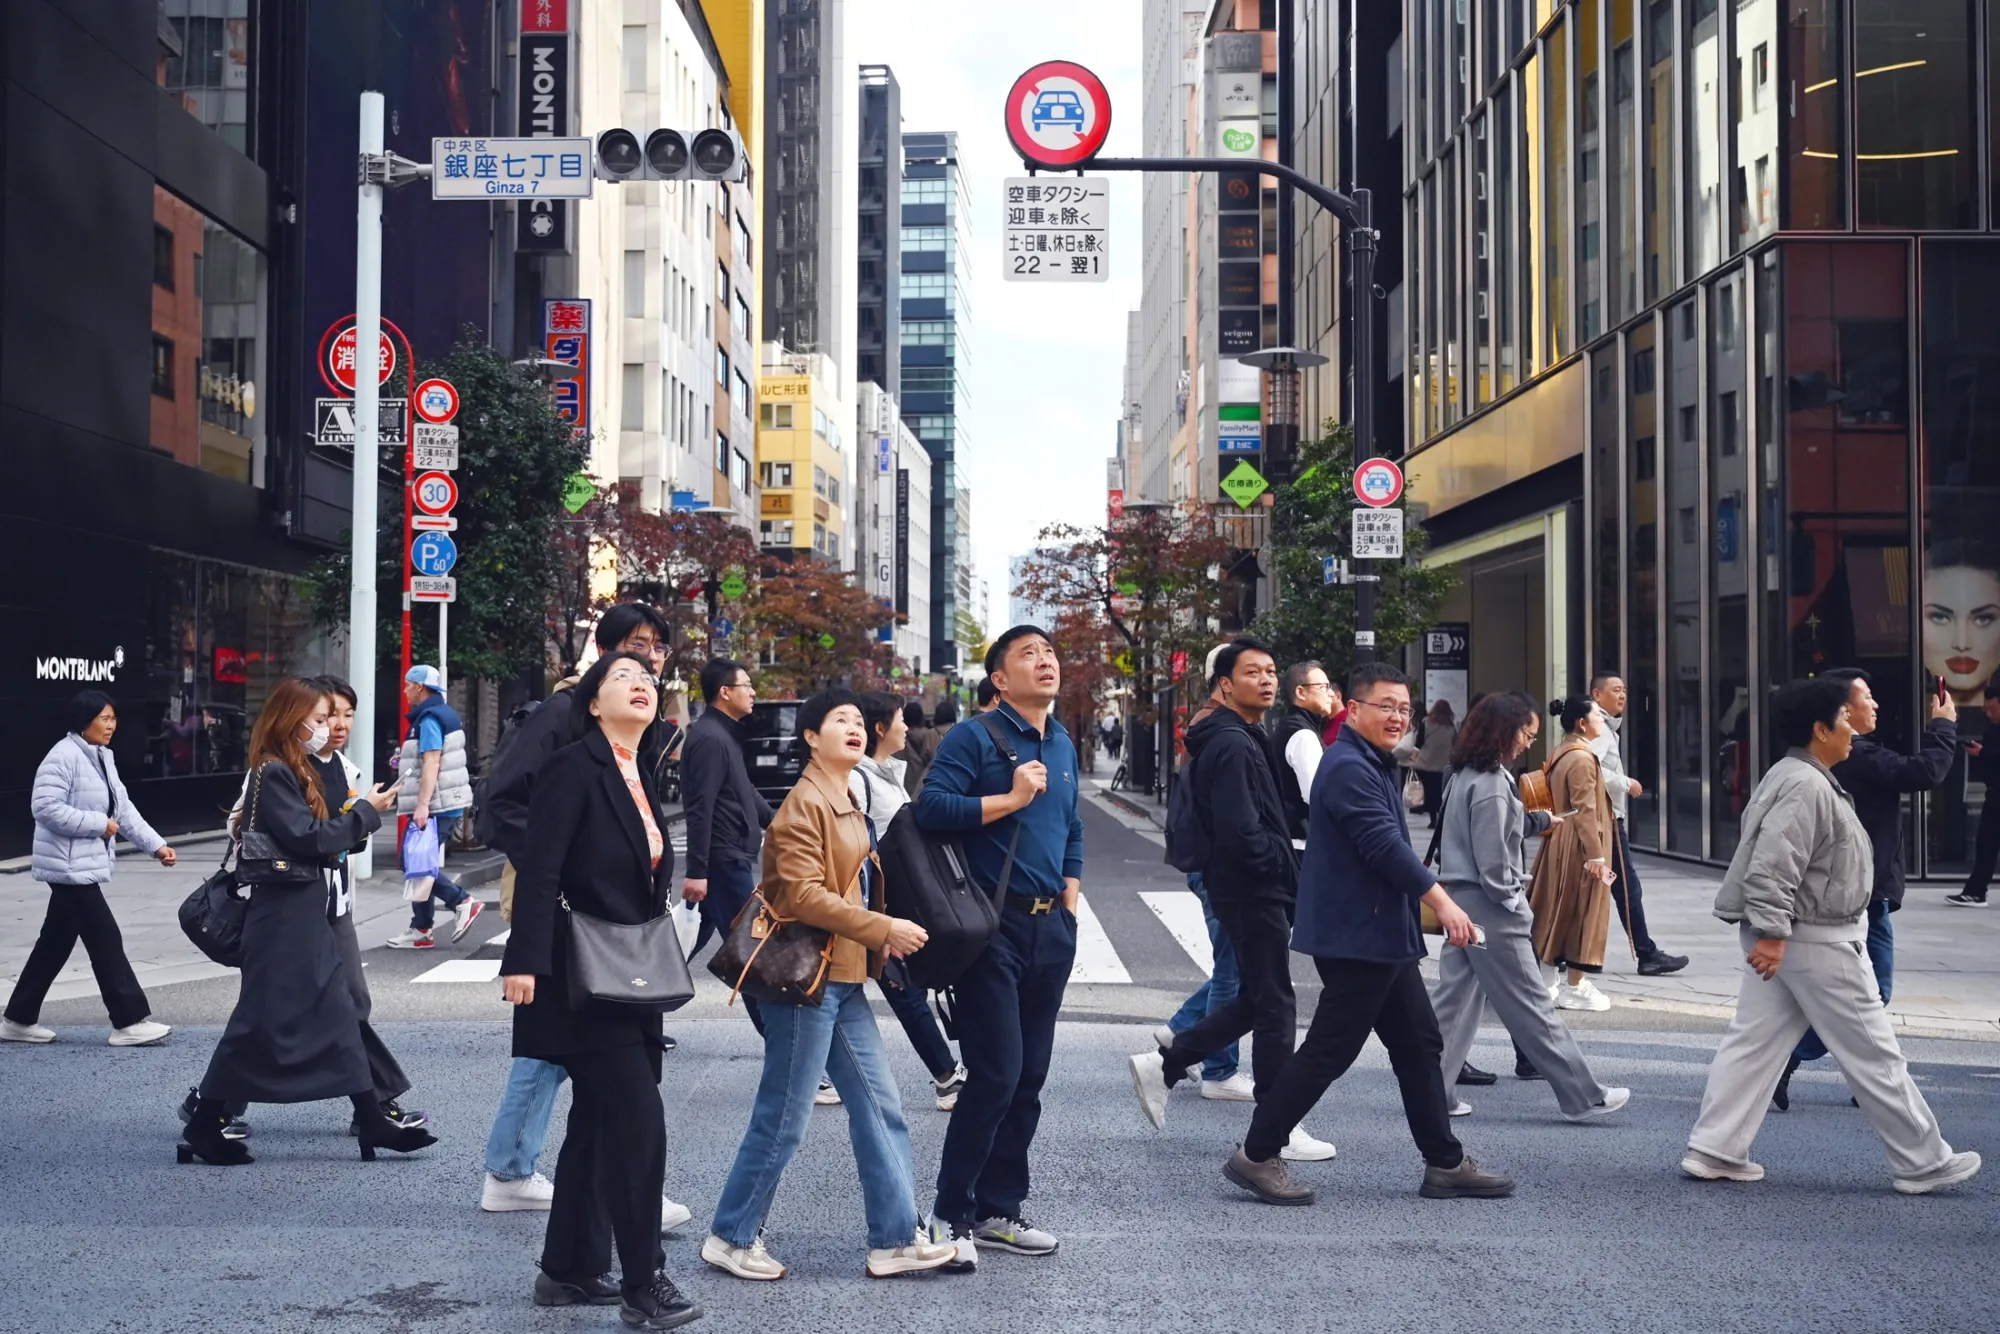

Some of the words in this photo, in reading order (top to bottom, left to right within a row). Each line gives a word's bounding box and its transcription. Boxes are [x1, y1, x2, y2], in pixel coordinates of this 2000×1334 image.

[444, 139, 487, 152] 中央区
[444, 153, 582, 179] 銀座七丁目
[485, 181, 525, 194] Ginza
[531, 180, 540, 194] 7
[1008, 185, 1105, 204] 空車タクシー
[1008, 207, 1090, 226] 迎車を除く
[550, 302, 585, 331] 薬
[417, 427, 456, 437] 空車タクシー
[1219, 424, 1259, 433] FamilyMart
[423, 483, 448, 503] 30
[1356, 513, 1399, 523] 空車タクシー
[421, 543, 439, 571] P
[433, 559, 446, 572] 60
[36, 656, 115, 683] MONTBLANC
